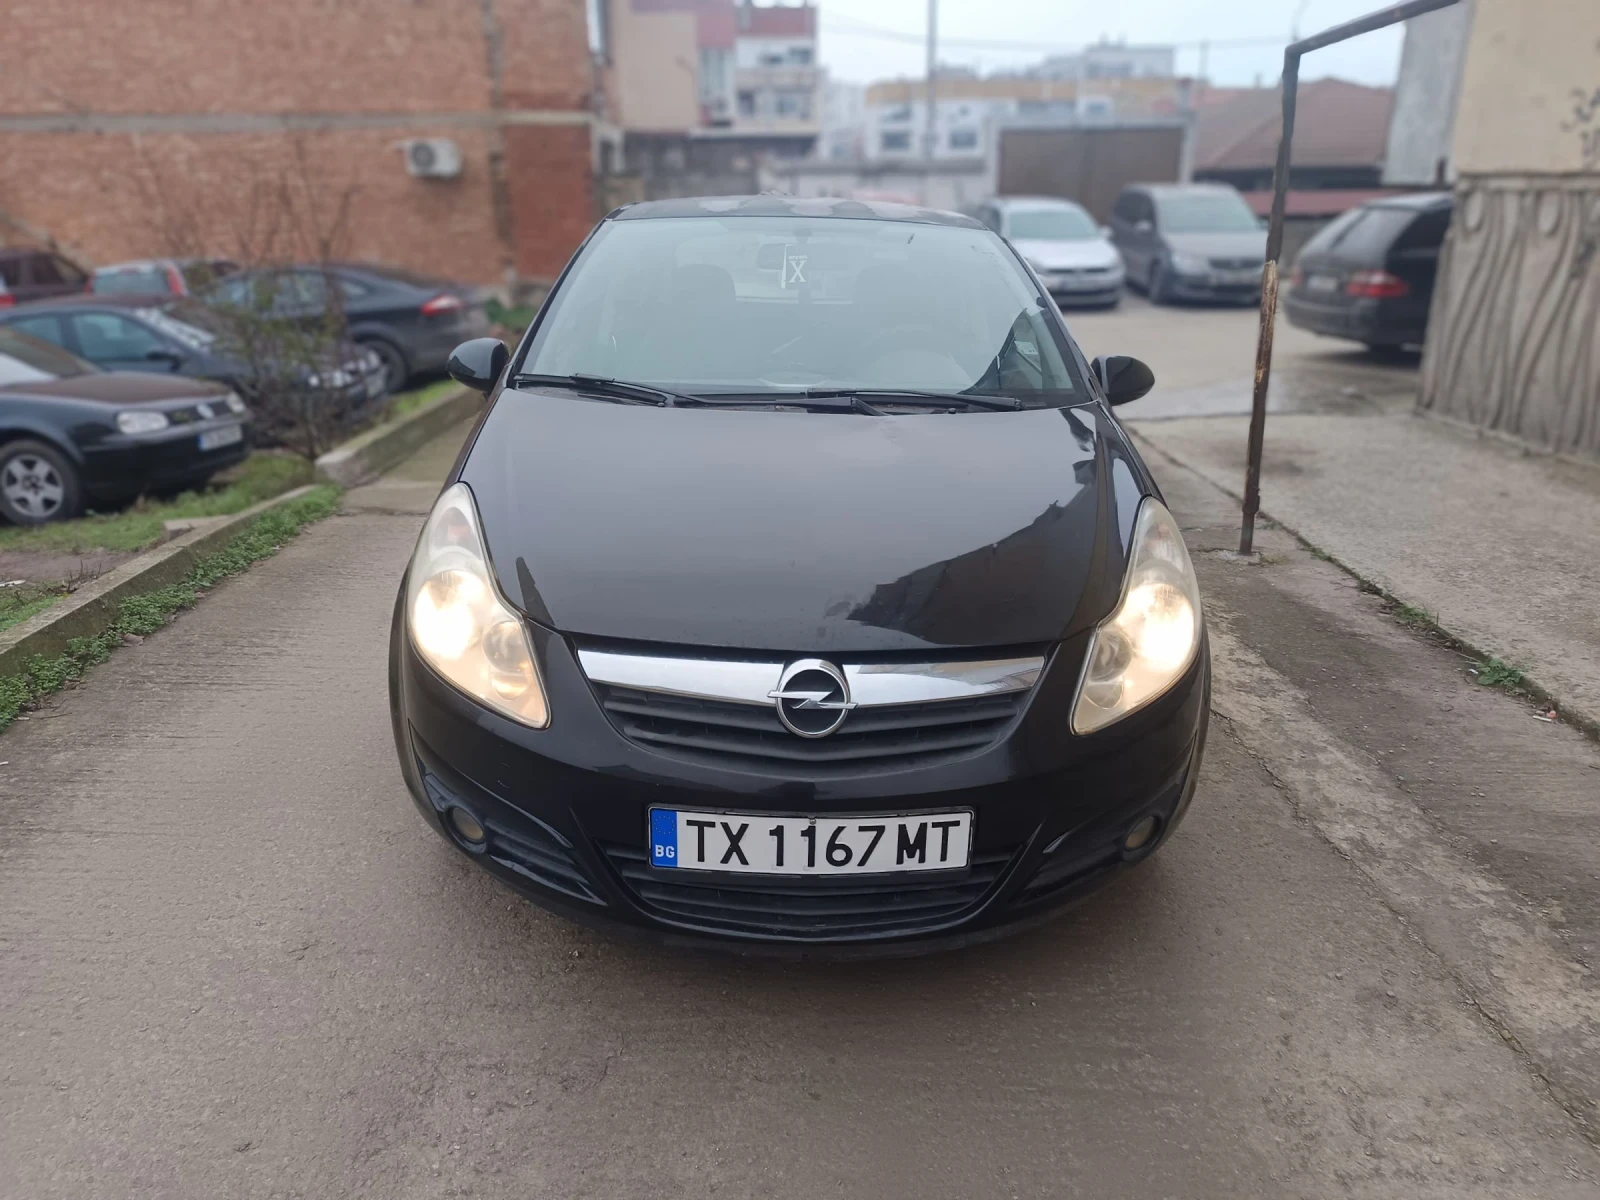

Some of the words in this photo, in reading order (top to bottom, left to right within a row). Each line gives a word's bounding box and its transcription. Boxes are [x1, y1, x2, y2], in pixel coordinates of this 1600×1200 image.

[655, 845, 675, 859] BG
[686, 819, 750, 866] TX
[769, 825, 886, 868] 1167
[896, 820, 961, 865] MT
